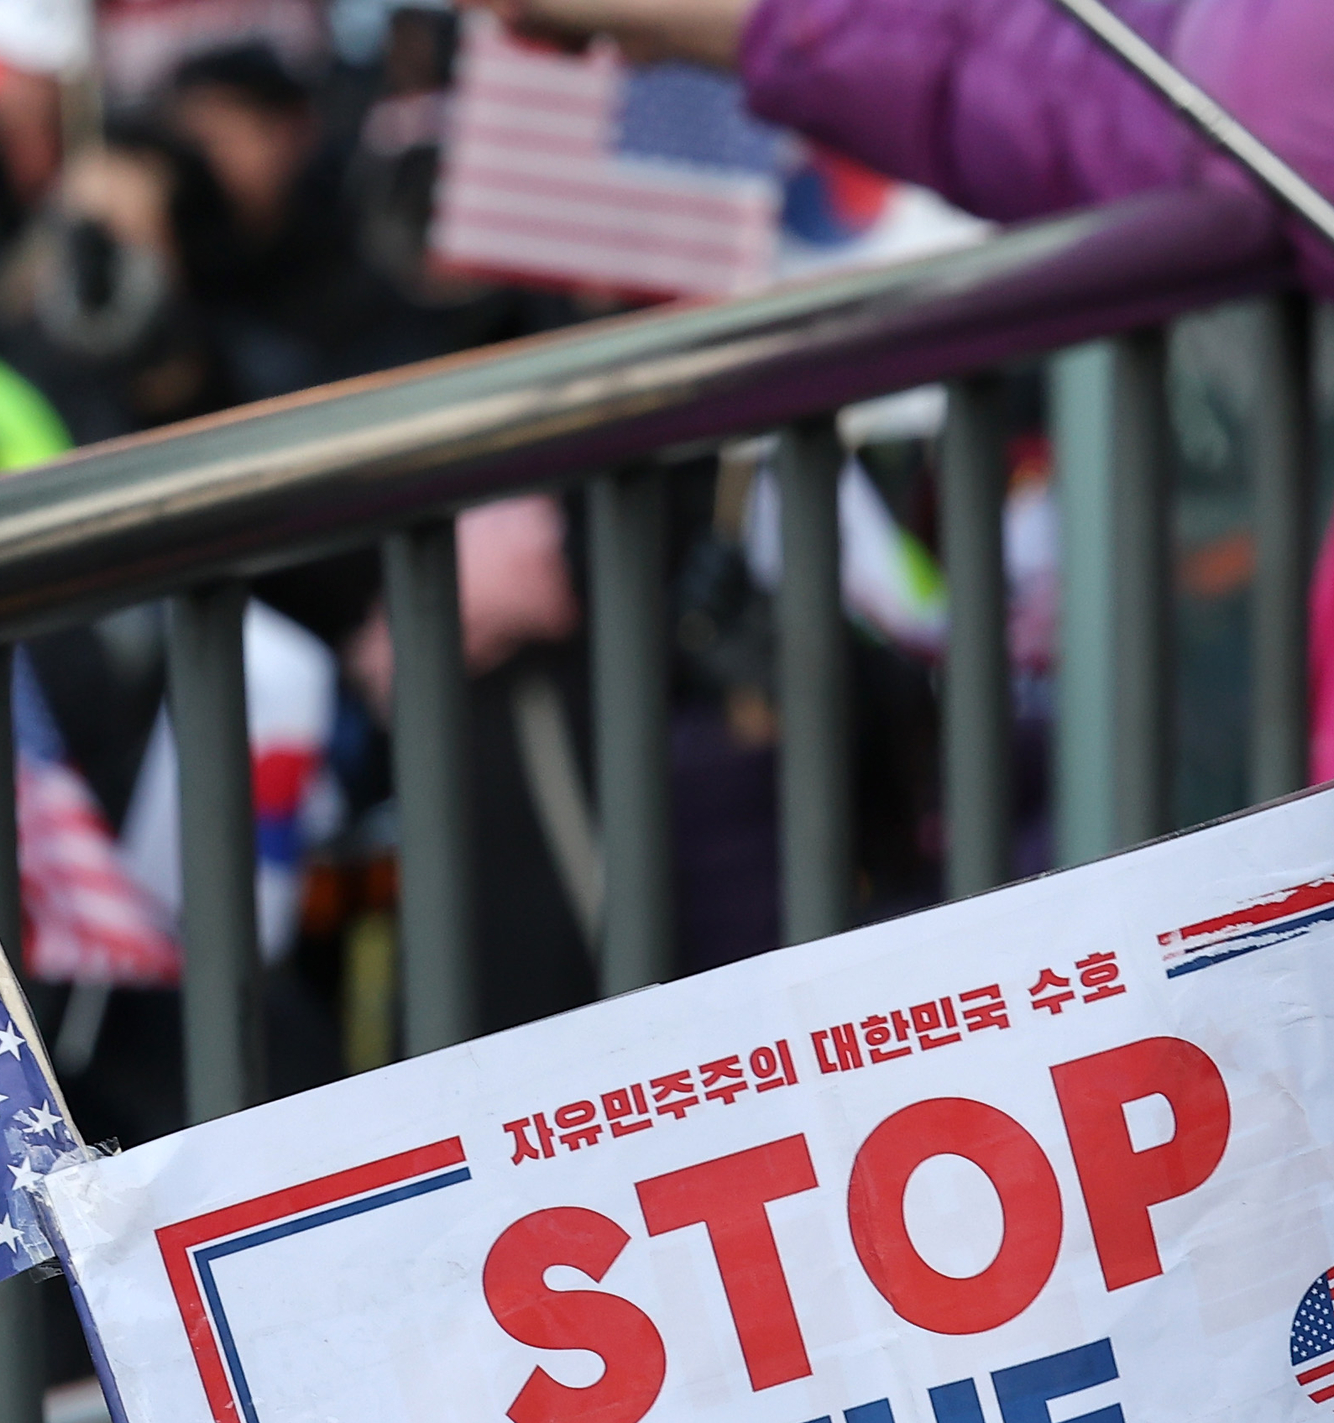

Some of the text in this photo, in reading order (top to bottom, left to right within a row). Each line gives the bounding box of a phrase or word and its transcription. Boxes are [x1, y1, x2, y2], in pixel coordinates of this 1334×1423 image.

[502, 950, 1128, 1166] 자유민주주의 대한민국 수호
